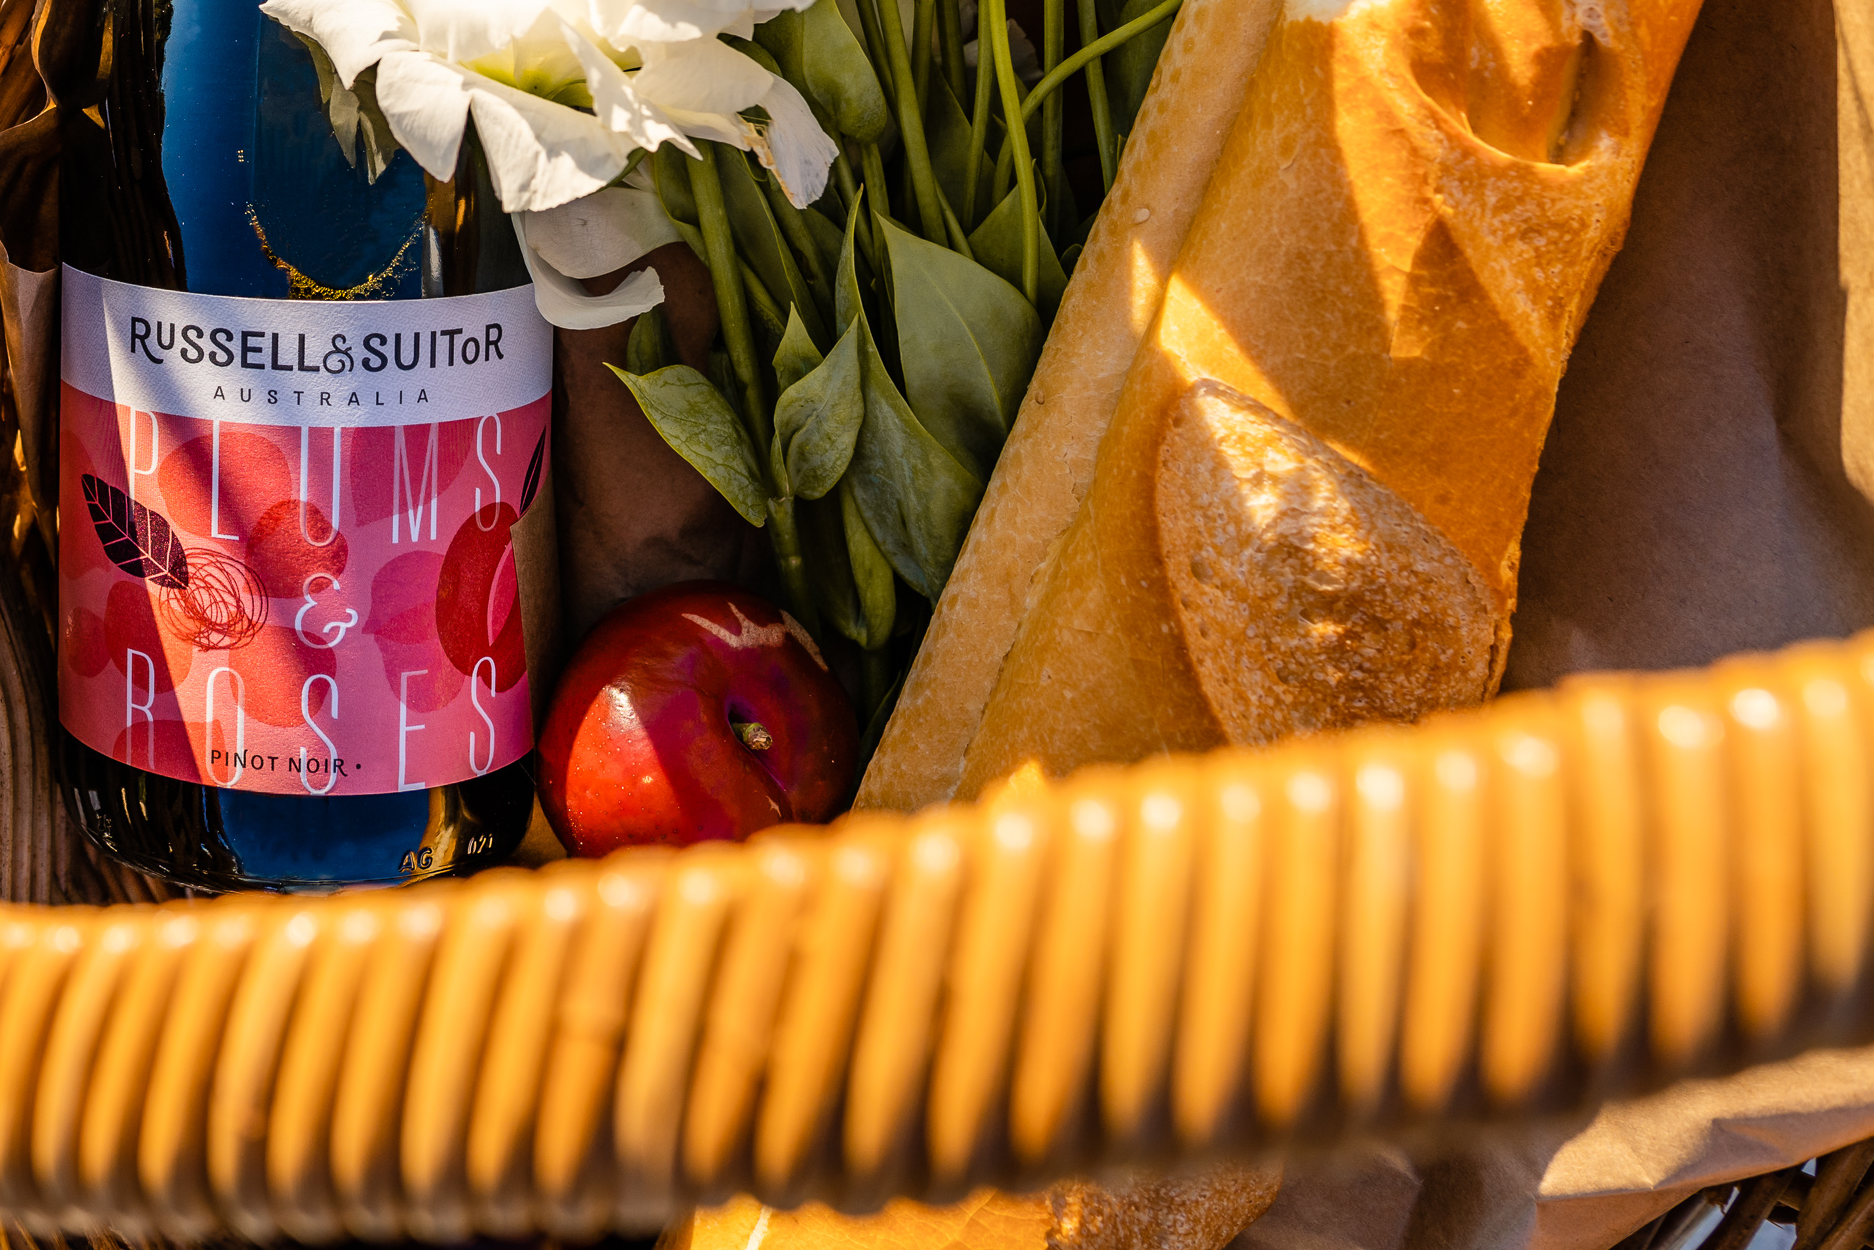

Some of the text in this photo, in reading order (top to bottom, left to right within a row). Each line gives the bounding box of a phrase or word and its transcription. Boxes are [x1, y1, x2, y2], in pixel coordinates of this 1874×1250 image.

[213, 385, 429, 407] AUSTRALIA
[127, 407, 504, 548] PLUMS
[294, 572, 359, 649] &
[126, 647, 499, 797] ROSES
[210, 749, 348, 777] PINOT NOIR
